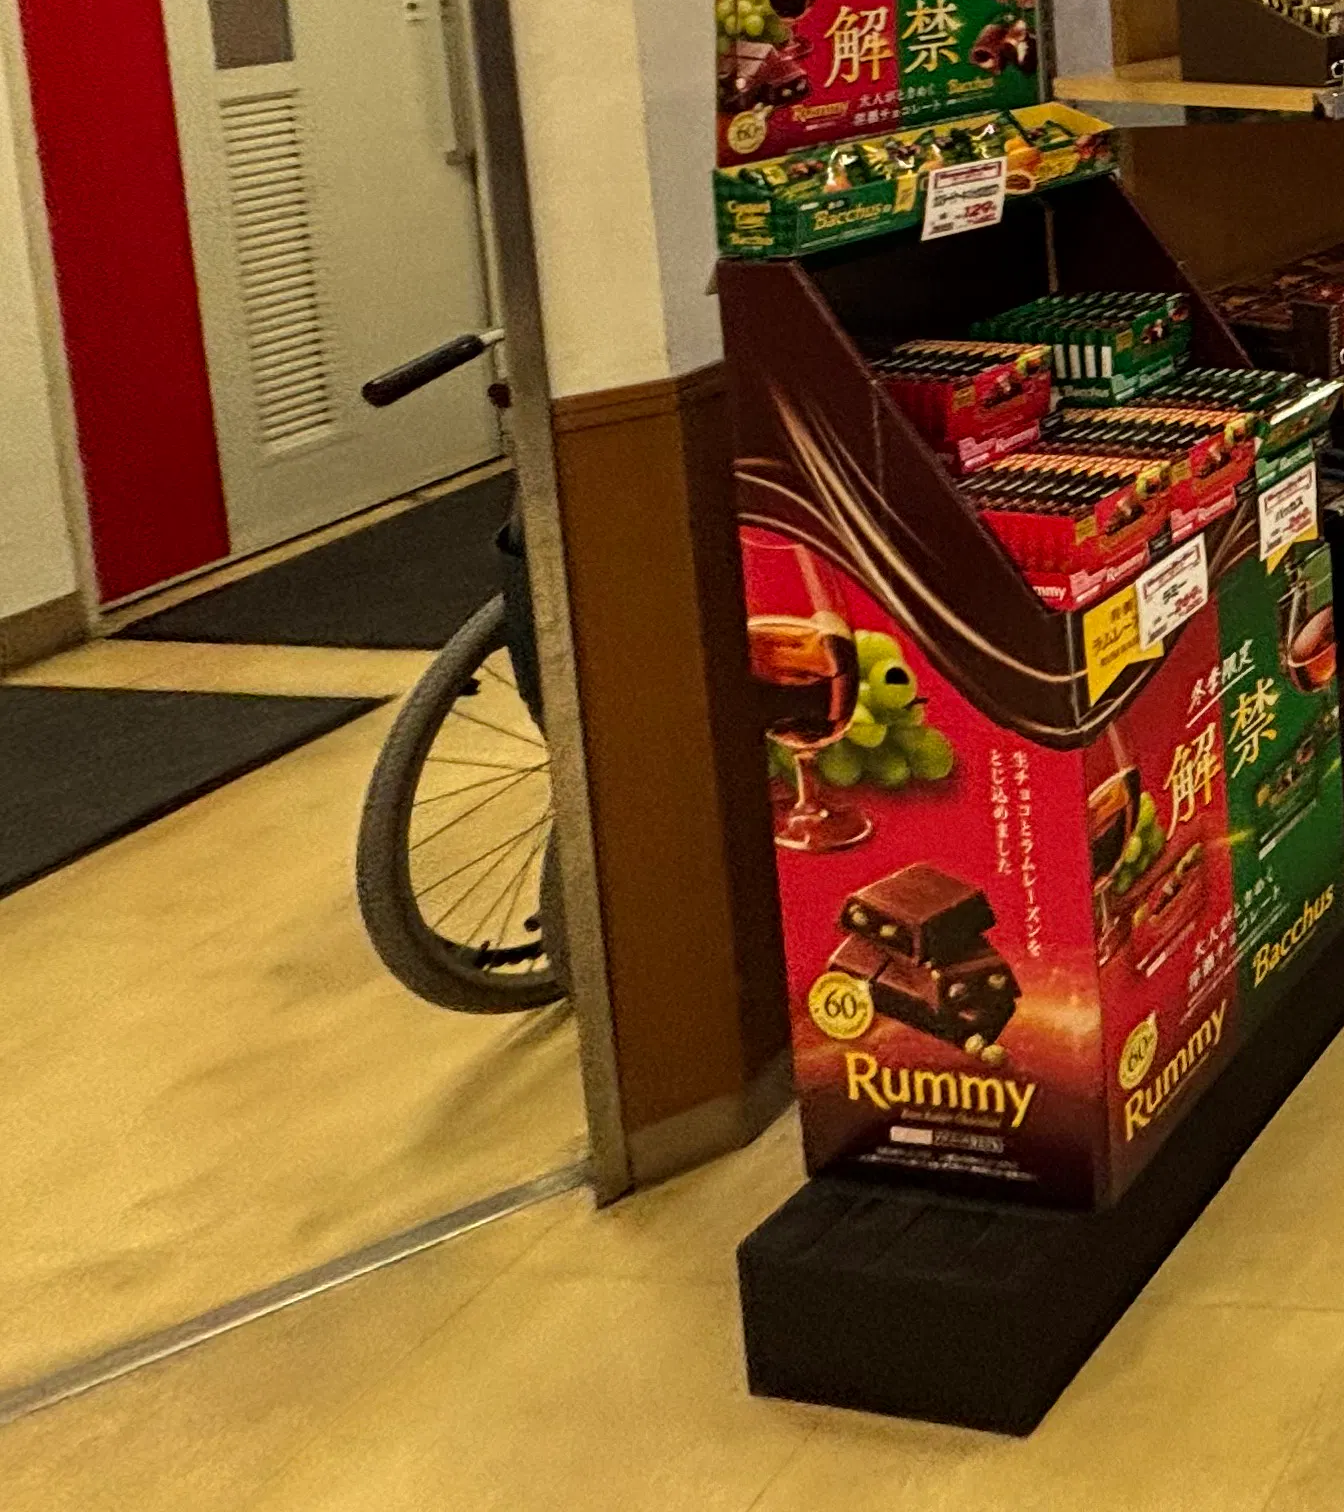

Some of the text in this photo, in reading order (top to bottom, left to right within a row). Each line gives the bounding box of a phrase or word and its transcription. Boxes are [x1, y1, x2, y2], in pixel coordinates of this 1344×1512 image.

[1163, 677, 1280, 840] 解禁
[1253, 884, 1336, 988] Bacchus
[844, 1051, 1037, 1128] Rummy
[1125, 999, 1228, 1143] Rummy
